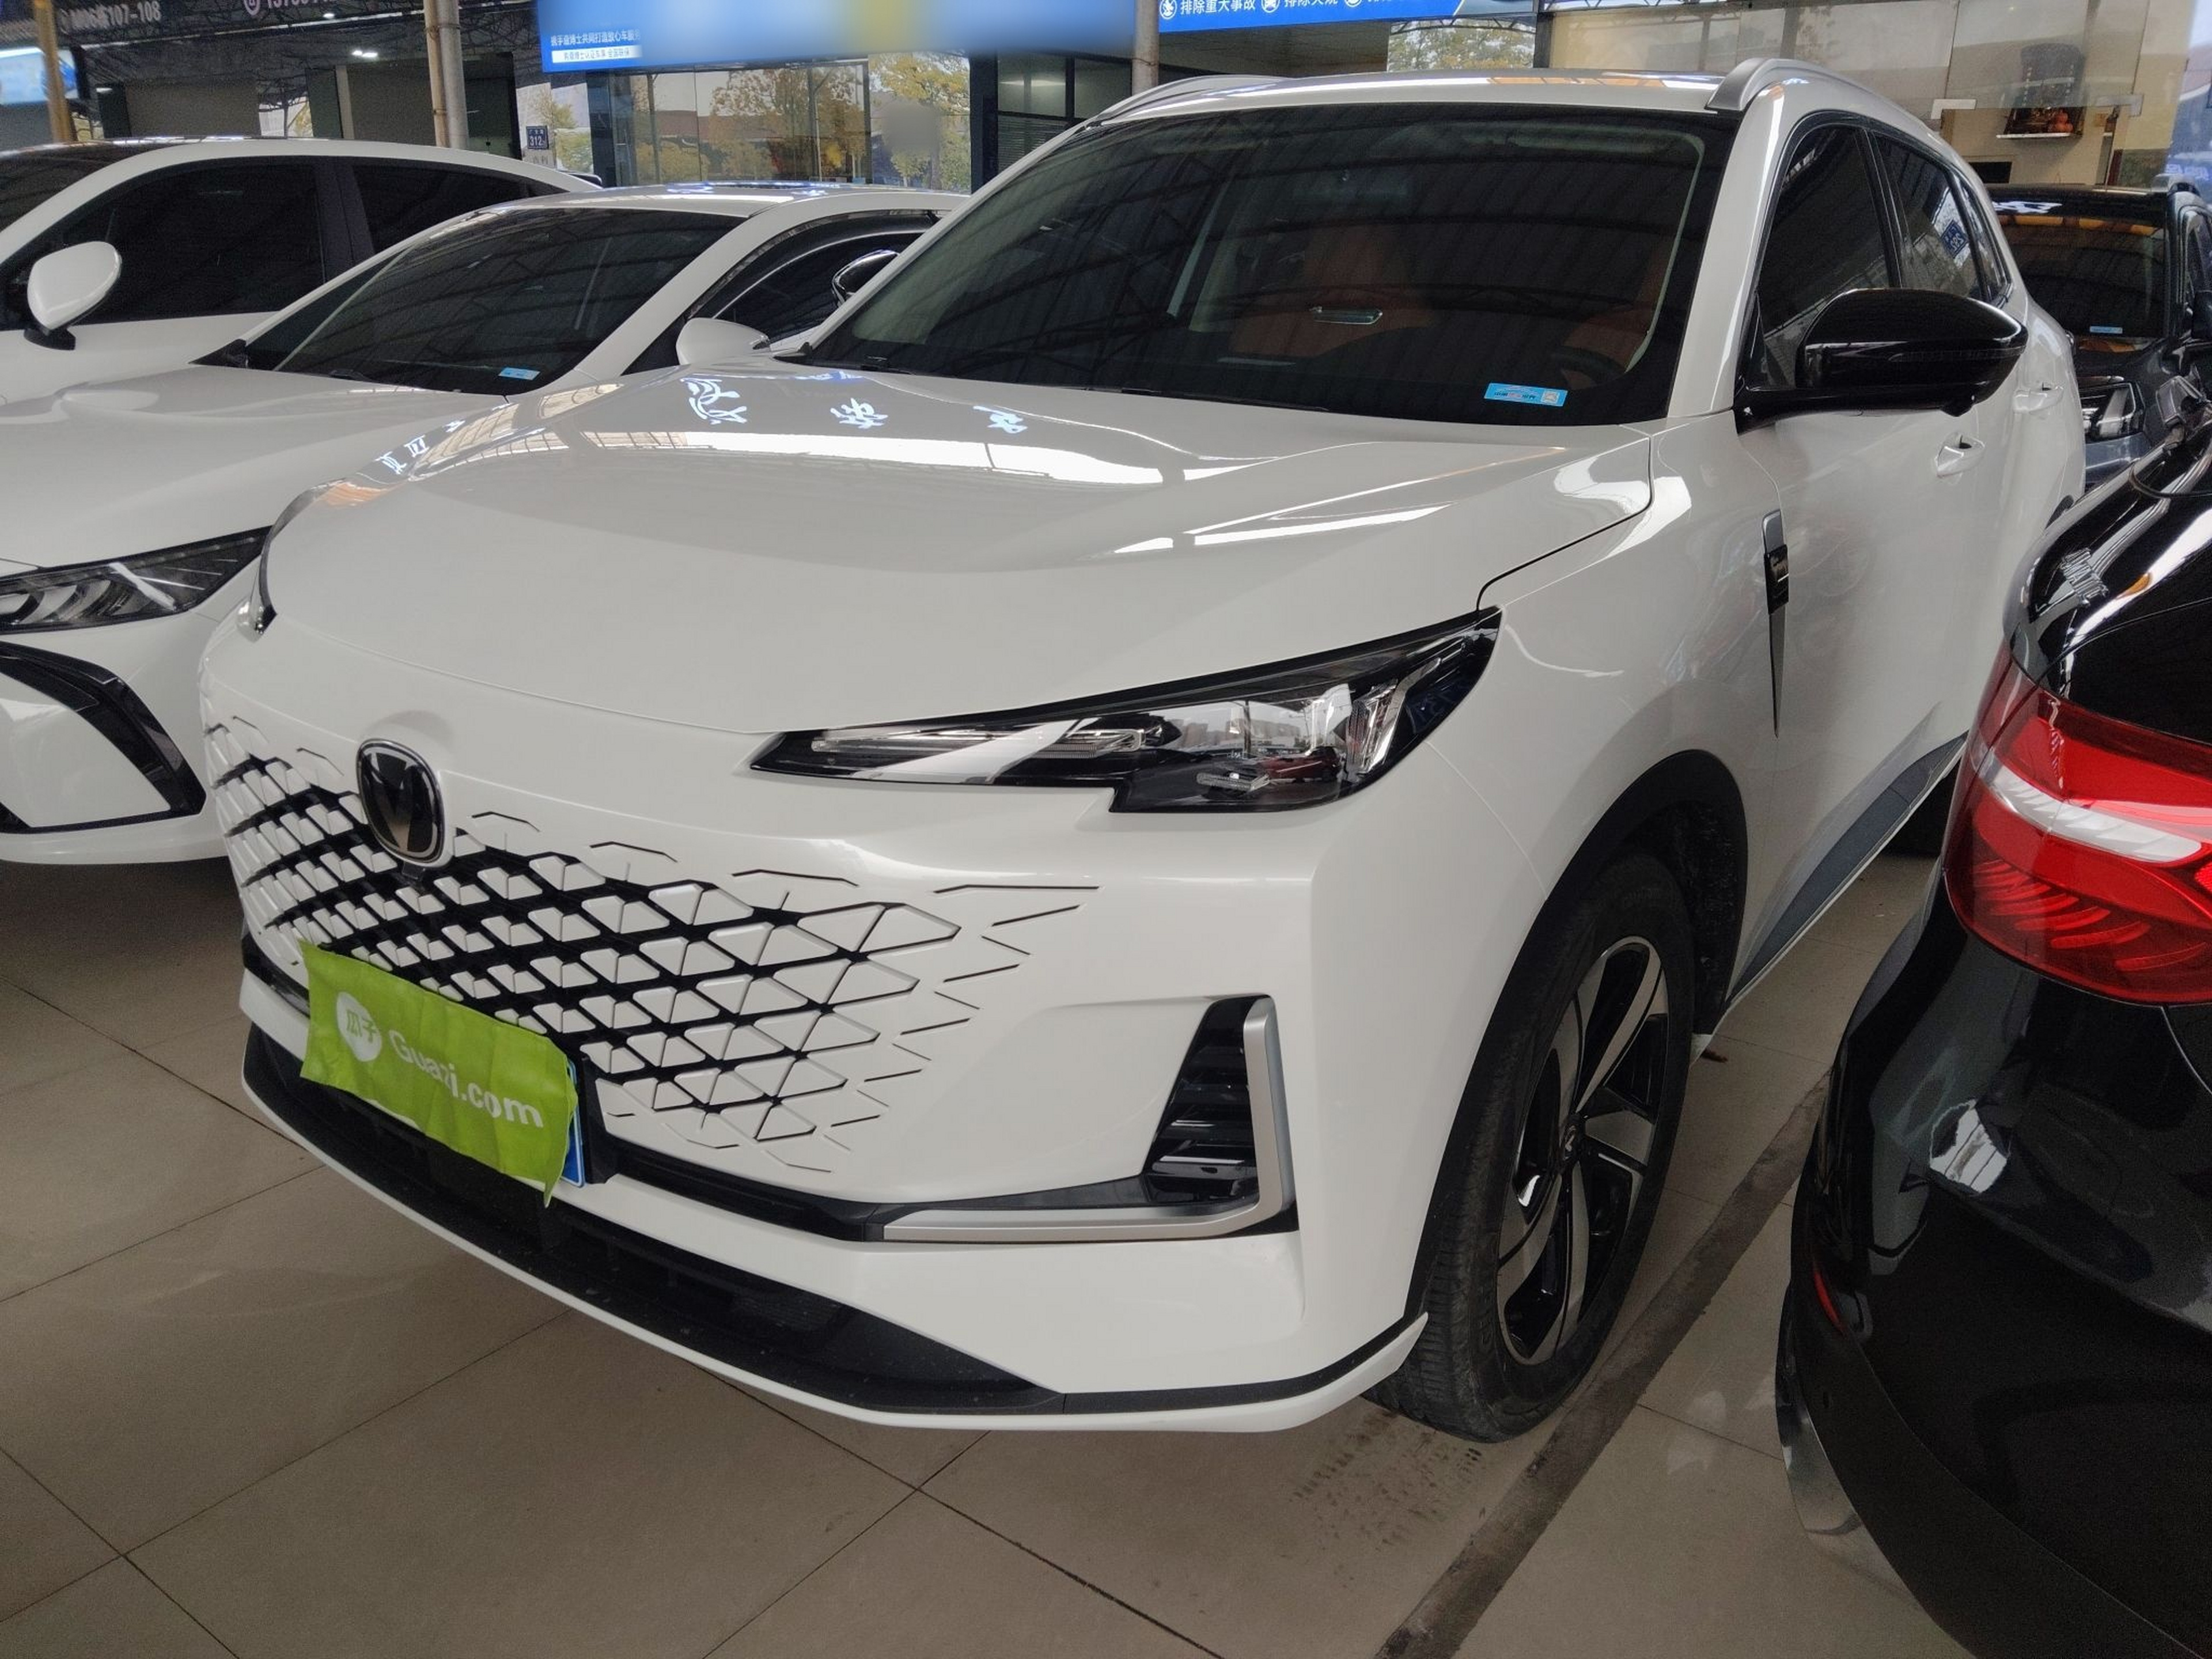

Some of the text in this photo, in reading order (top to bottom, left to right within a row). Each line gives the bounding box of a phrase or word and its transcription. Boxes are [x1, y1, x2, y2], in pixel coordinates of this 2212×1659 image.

[1181, 0, 1255, 14] 排除重大事故
[346, 1009, 377, 1043] 瓜子
[388, 1030, 544, 1128] Guazi.com
